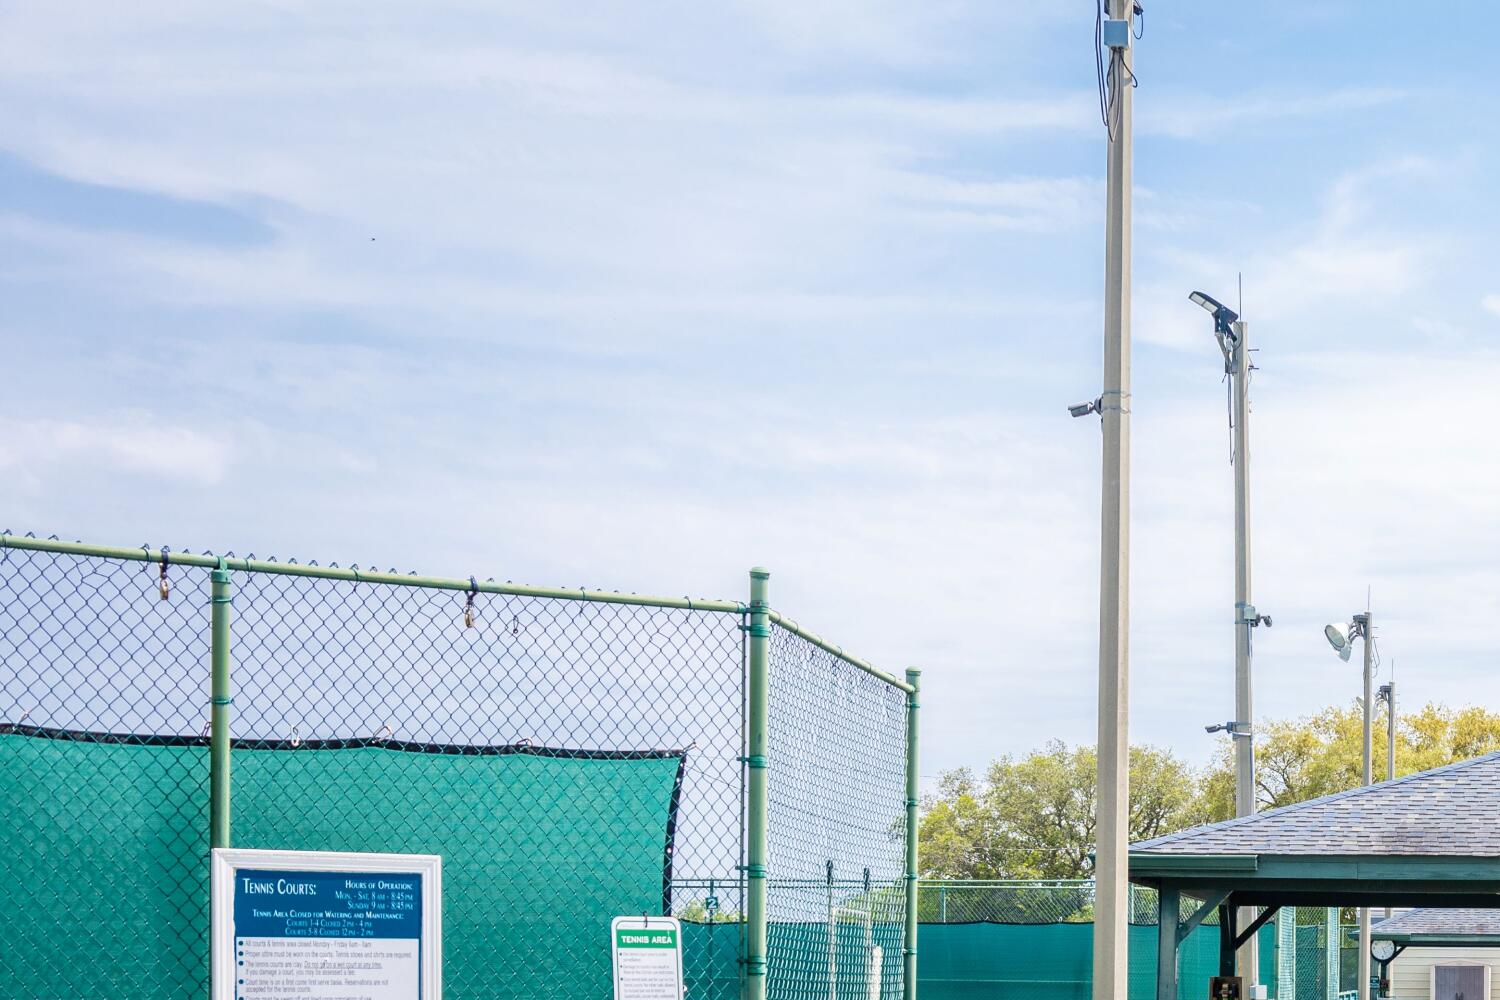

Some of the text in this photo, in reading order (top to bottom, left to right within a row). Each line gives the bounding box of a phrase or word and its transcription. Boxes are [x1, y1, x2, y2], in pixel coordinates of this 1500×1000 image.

[242, 878, 316, 895] TENNIS COURTS:
[708, 898, 716, 908] 2
[621, 936, 672, 944] TENNIS AREA
